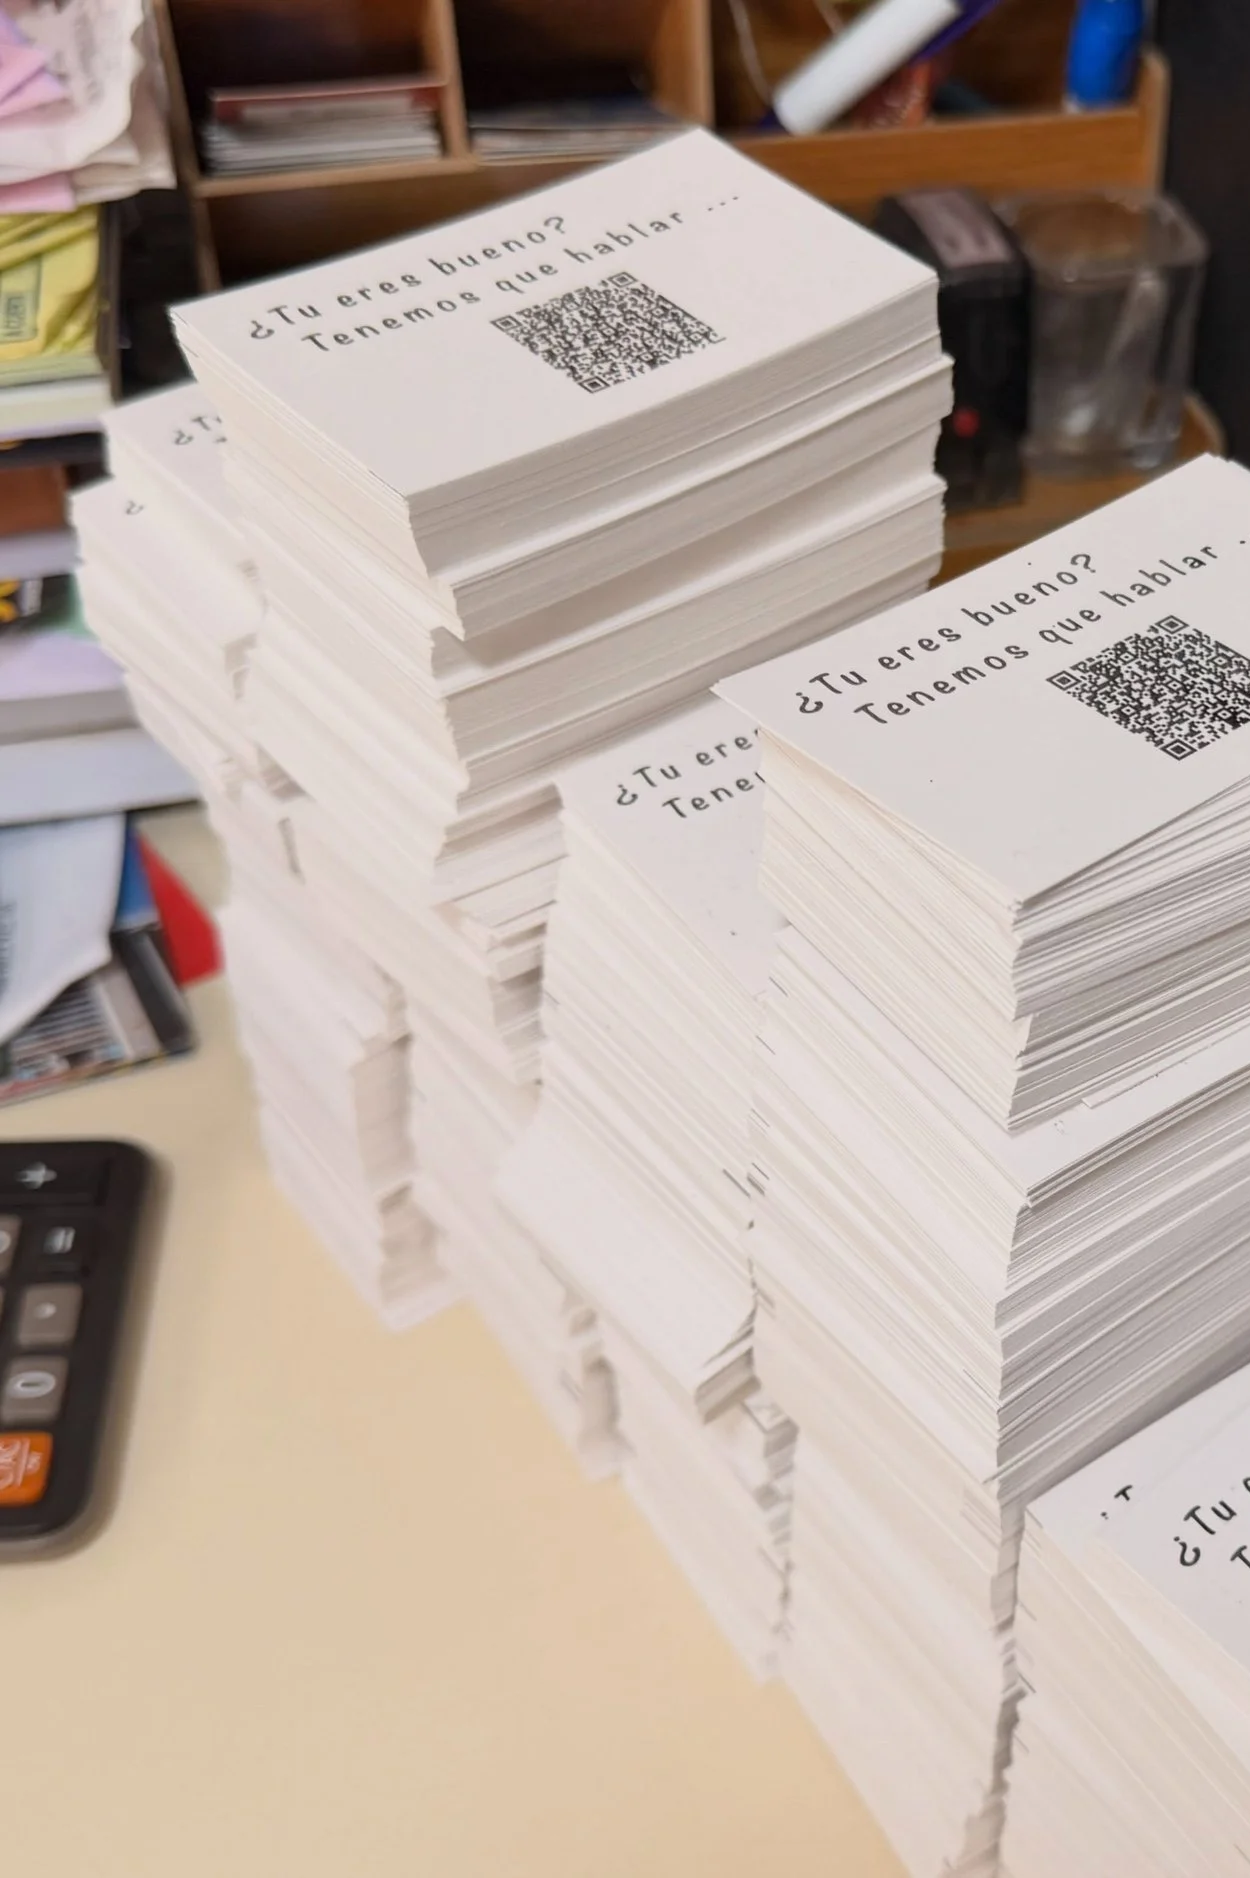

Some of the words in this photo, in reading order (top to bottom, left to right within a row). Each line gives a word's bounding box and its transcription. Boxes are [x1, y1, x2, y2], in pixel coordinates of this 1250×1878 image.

[250, 304, 322, 341] ¿Tu
[337, 273, 422, 308] eres
[428, 215, 566, 276] bueno?
[301, 291, 481, 352] Tenemos
[495, 263, 559, 294] que
[563, 211, 684, 264] hablar
[795, 670, 868, 714] ¿Tu
[877, 627, 962, 670] eres
[960, 553, 1096, 627] bueno?
[853, 644, 1029, 724] Tenemos
[1038, 608, 1101, 645] que
[1099, 545, 1218, 607] hablar
[616, 765, 682, 806] ¿Tu
[695, 729, 759, 766] ere
[662, 771, 766, 818] Tene
[1173, 1500, 1237, 1567] ¿Tu
